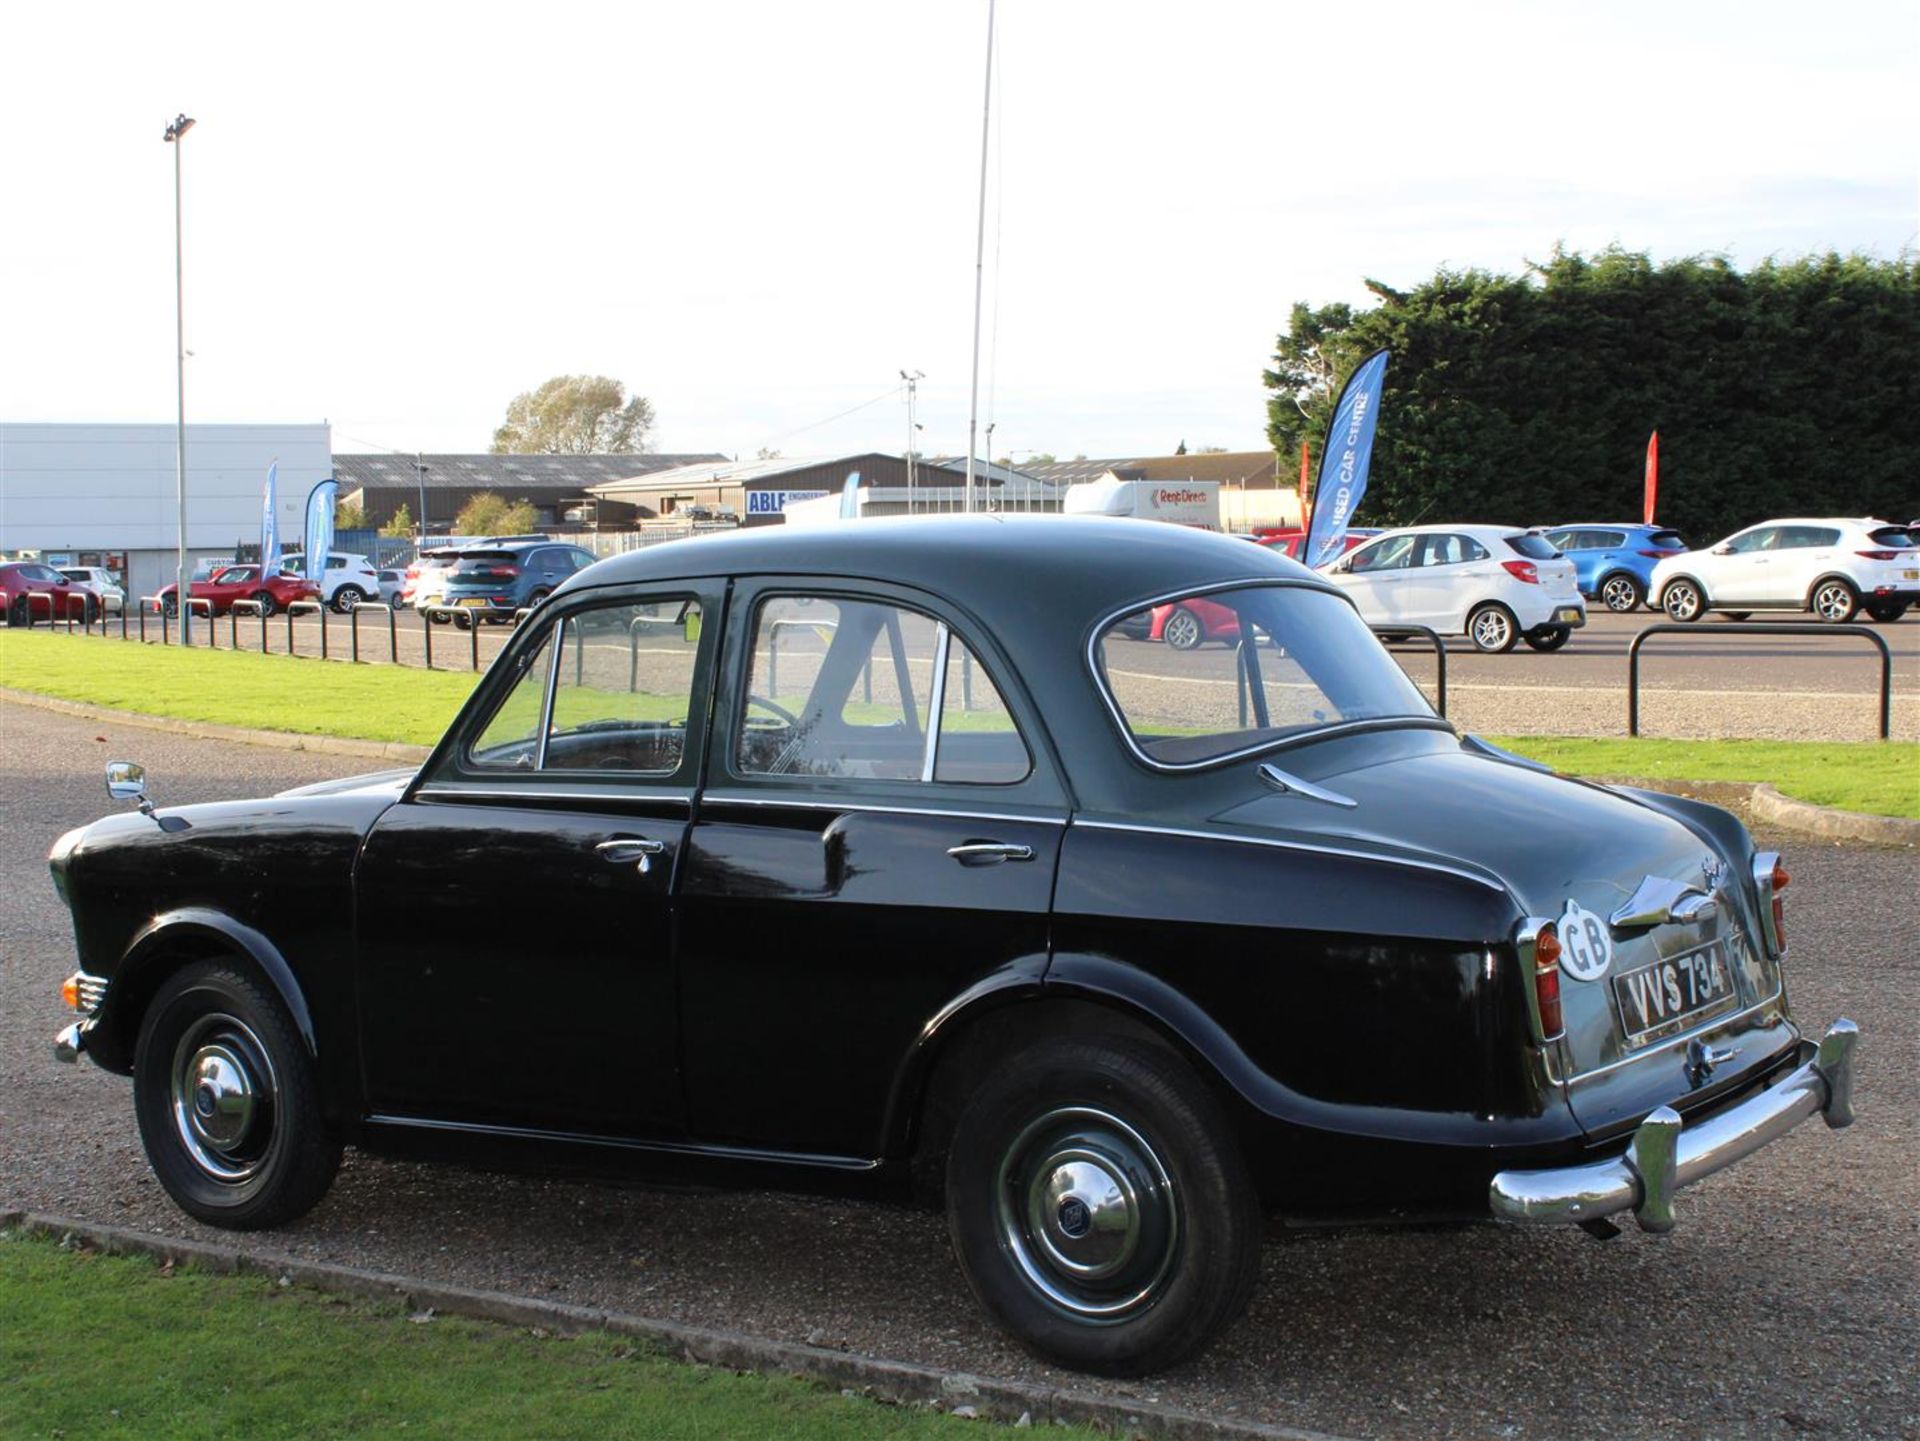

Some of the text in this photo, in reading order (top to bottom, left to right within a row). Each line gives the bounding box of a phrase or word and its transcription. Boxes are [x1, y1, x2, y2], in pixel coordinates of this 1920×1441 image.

[1347, 391, 1369, 446] CENTRE
[1340, 449, 1356, 483] CAR
[1566, 918, 1607, 972] GB
[1627, 948, 1725, 1028] VVS 734
